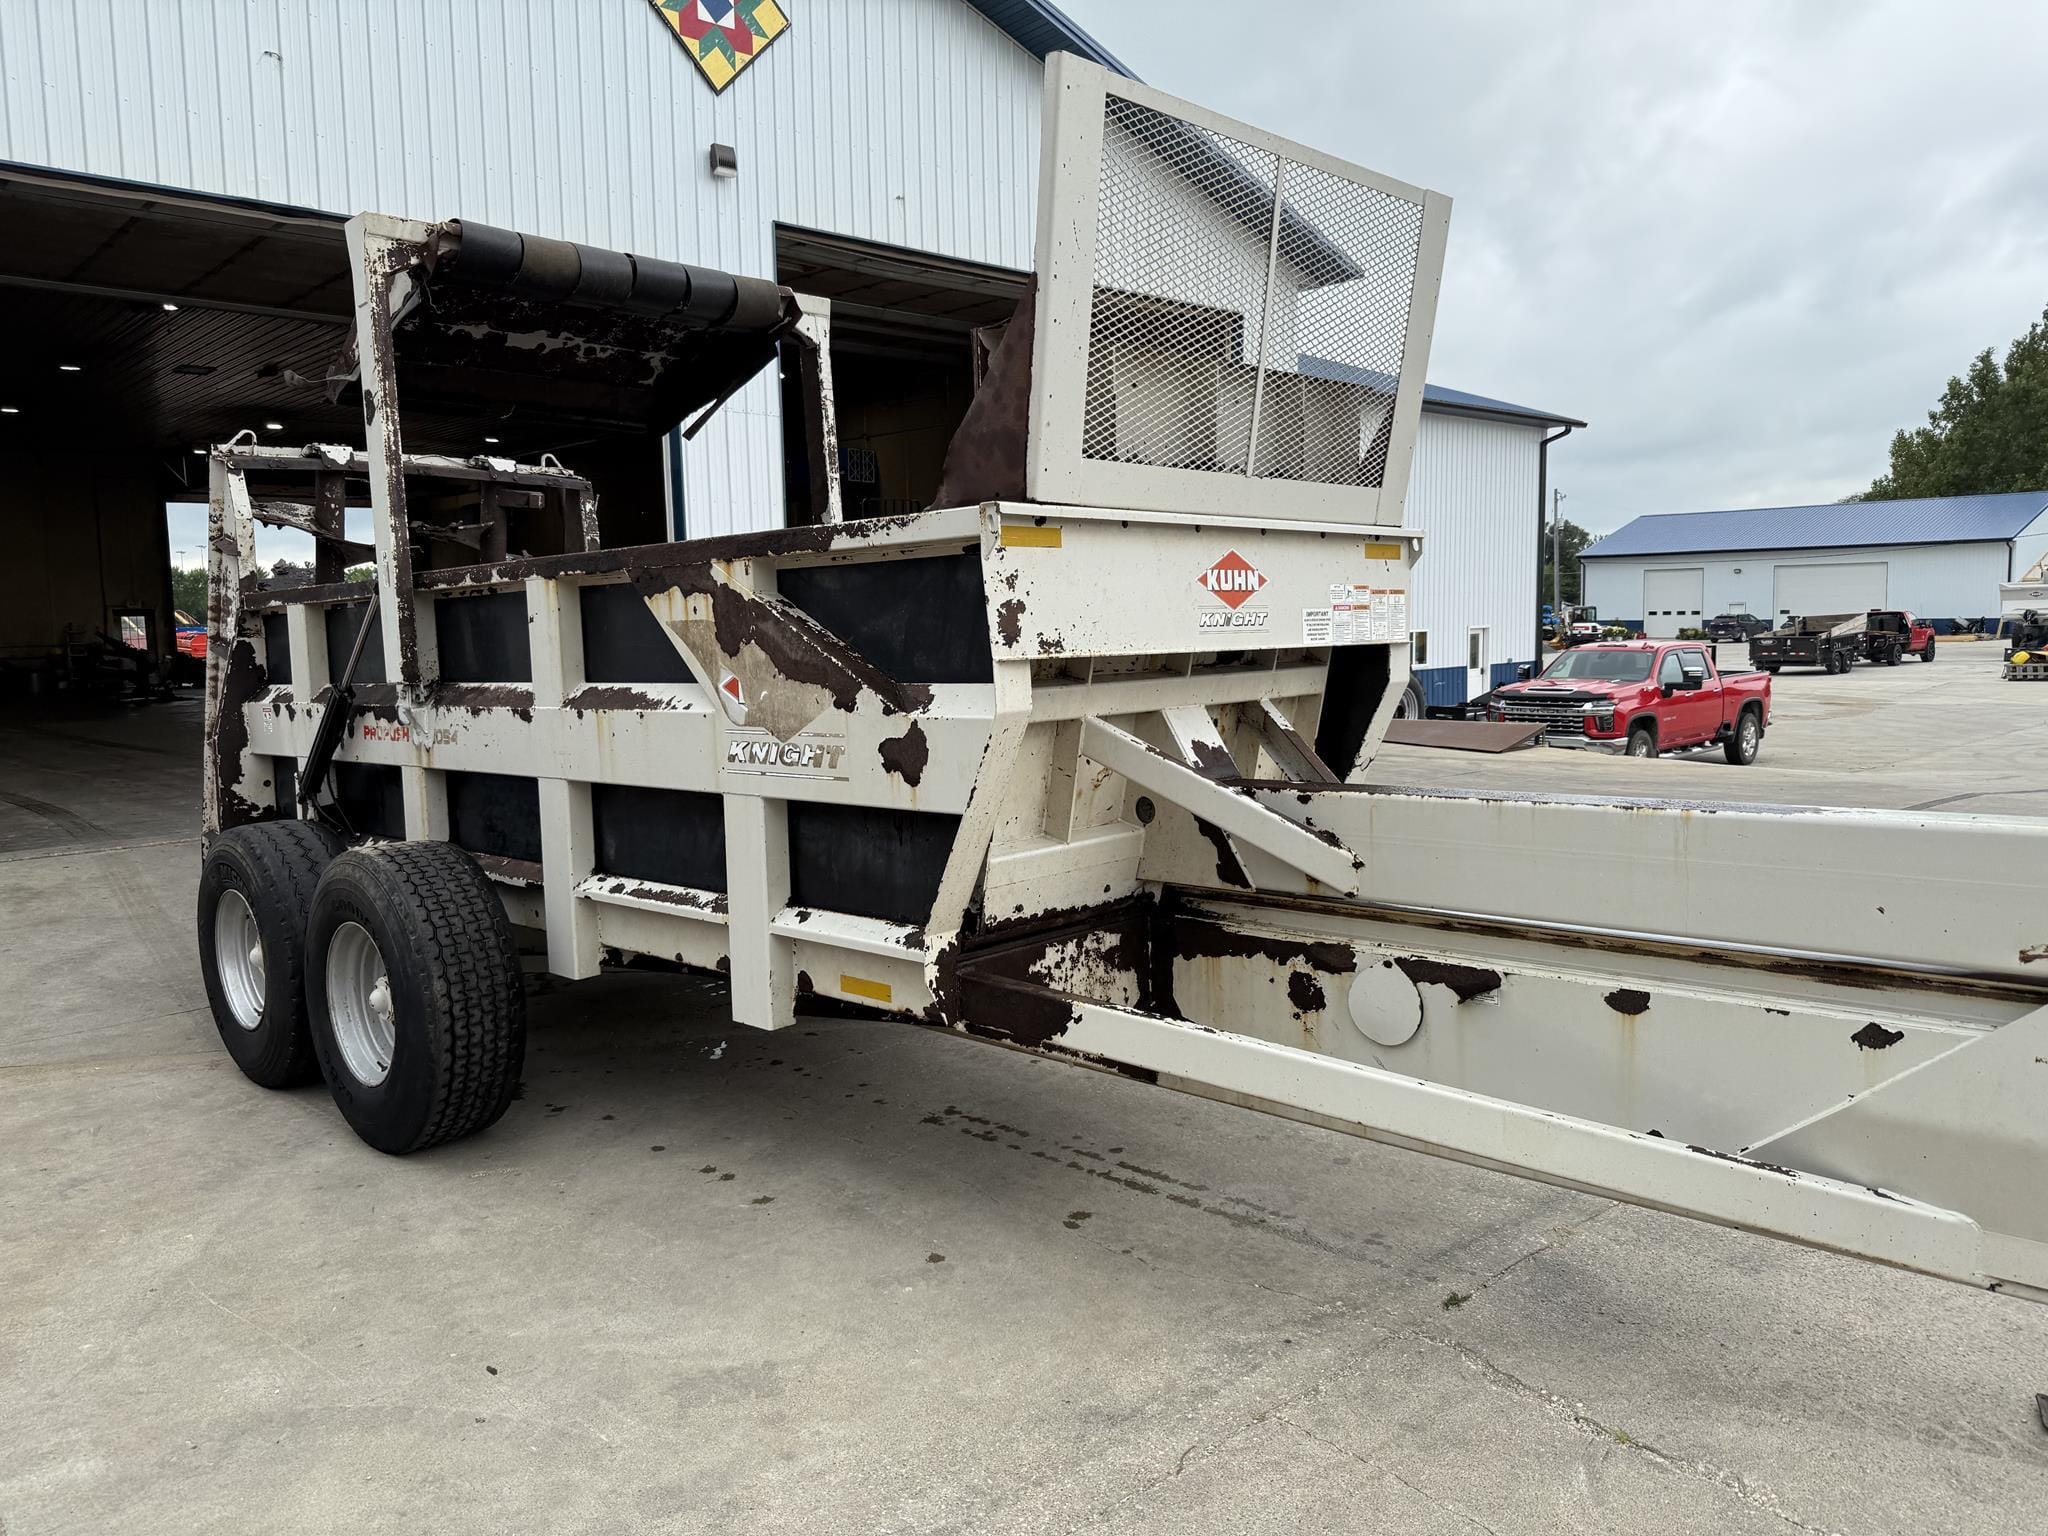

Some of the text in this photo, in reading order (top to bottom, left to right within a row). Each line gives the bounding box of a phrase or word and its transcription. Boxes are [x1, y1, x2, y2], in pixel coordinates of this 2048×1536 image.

[1206, 569, 1260, 592] KUHN
[1199, 611, 1269, 628] KNIGHT
[727, 740, 846, 769] KNIGHT
